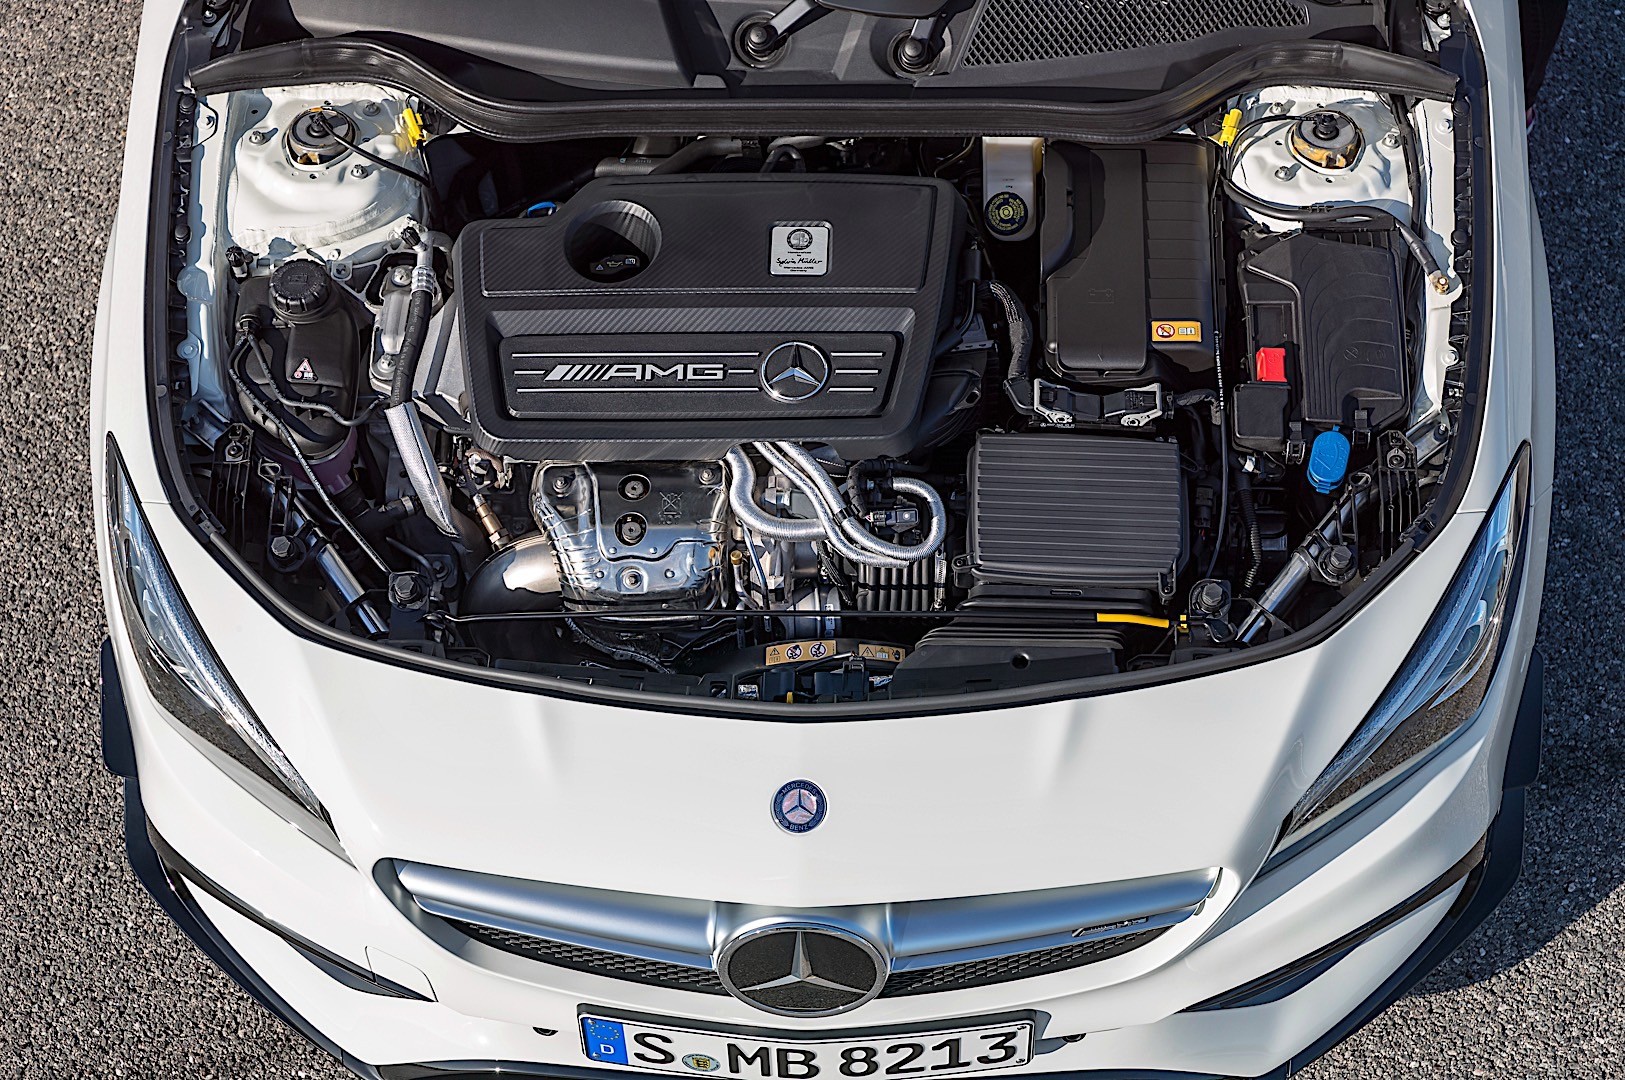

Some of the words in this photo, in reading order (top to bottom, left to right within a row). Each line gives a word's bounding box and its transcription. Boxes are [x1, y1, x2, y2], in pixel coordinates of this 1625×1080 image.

[601, 363, 727, 382] AMG
[789, 823, 809, 831] BENZ
[600, 1043, 615, 1055] D
[633, 1032, 676, 1065] S
[726, 1042, 820, 1079] MB
[839, 1030, 1019, 1077] 8213
